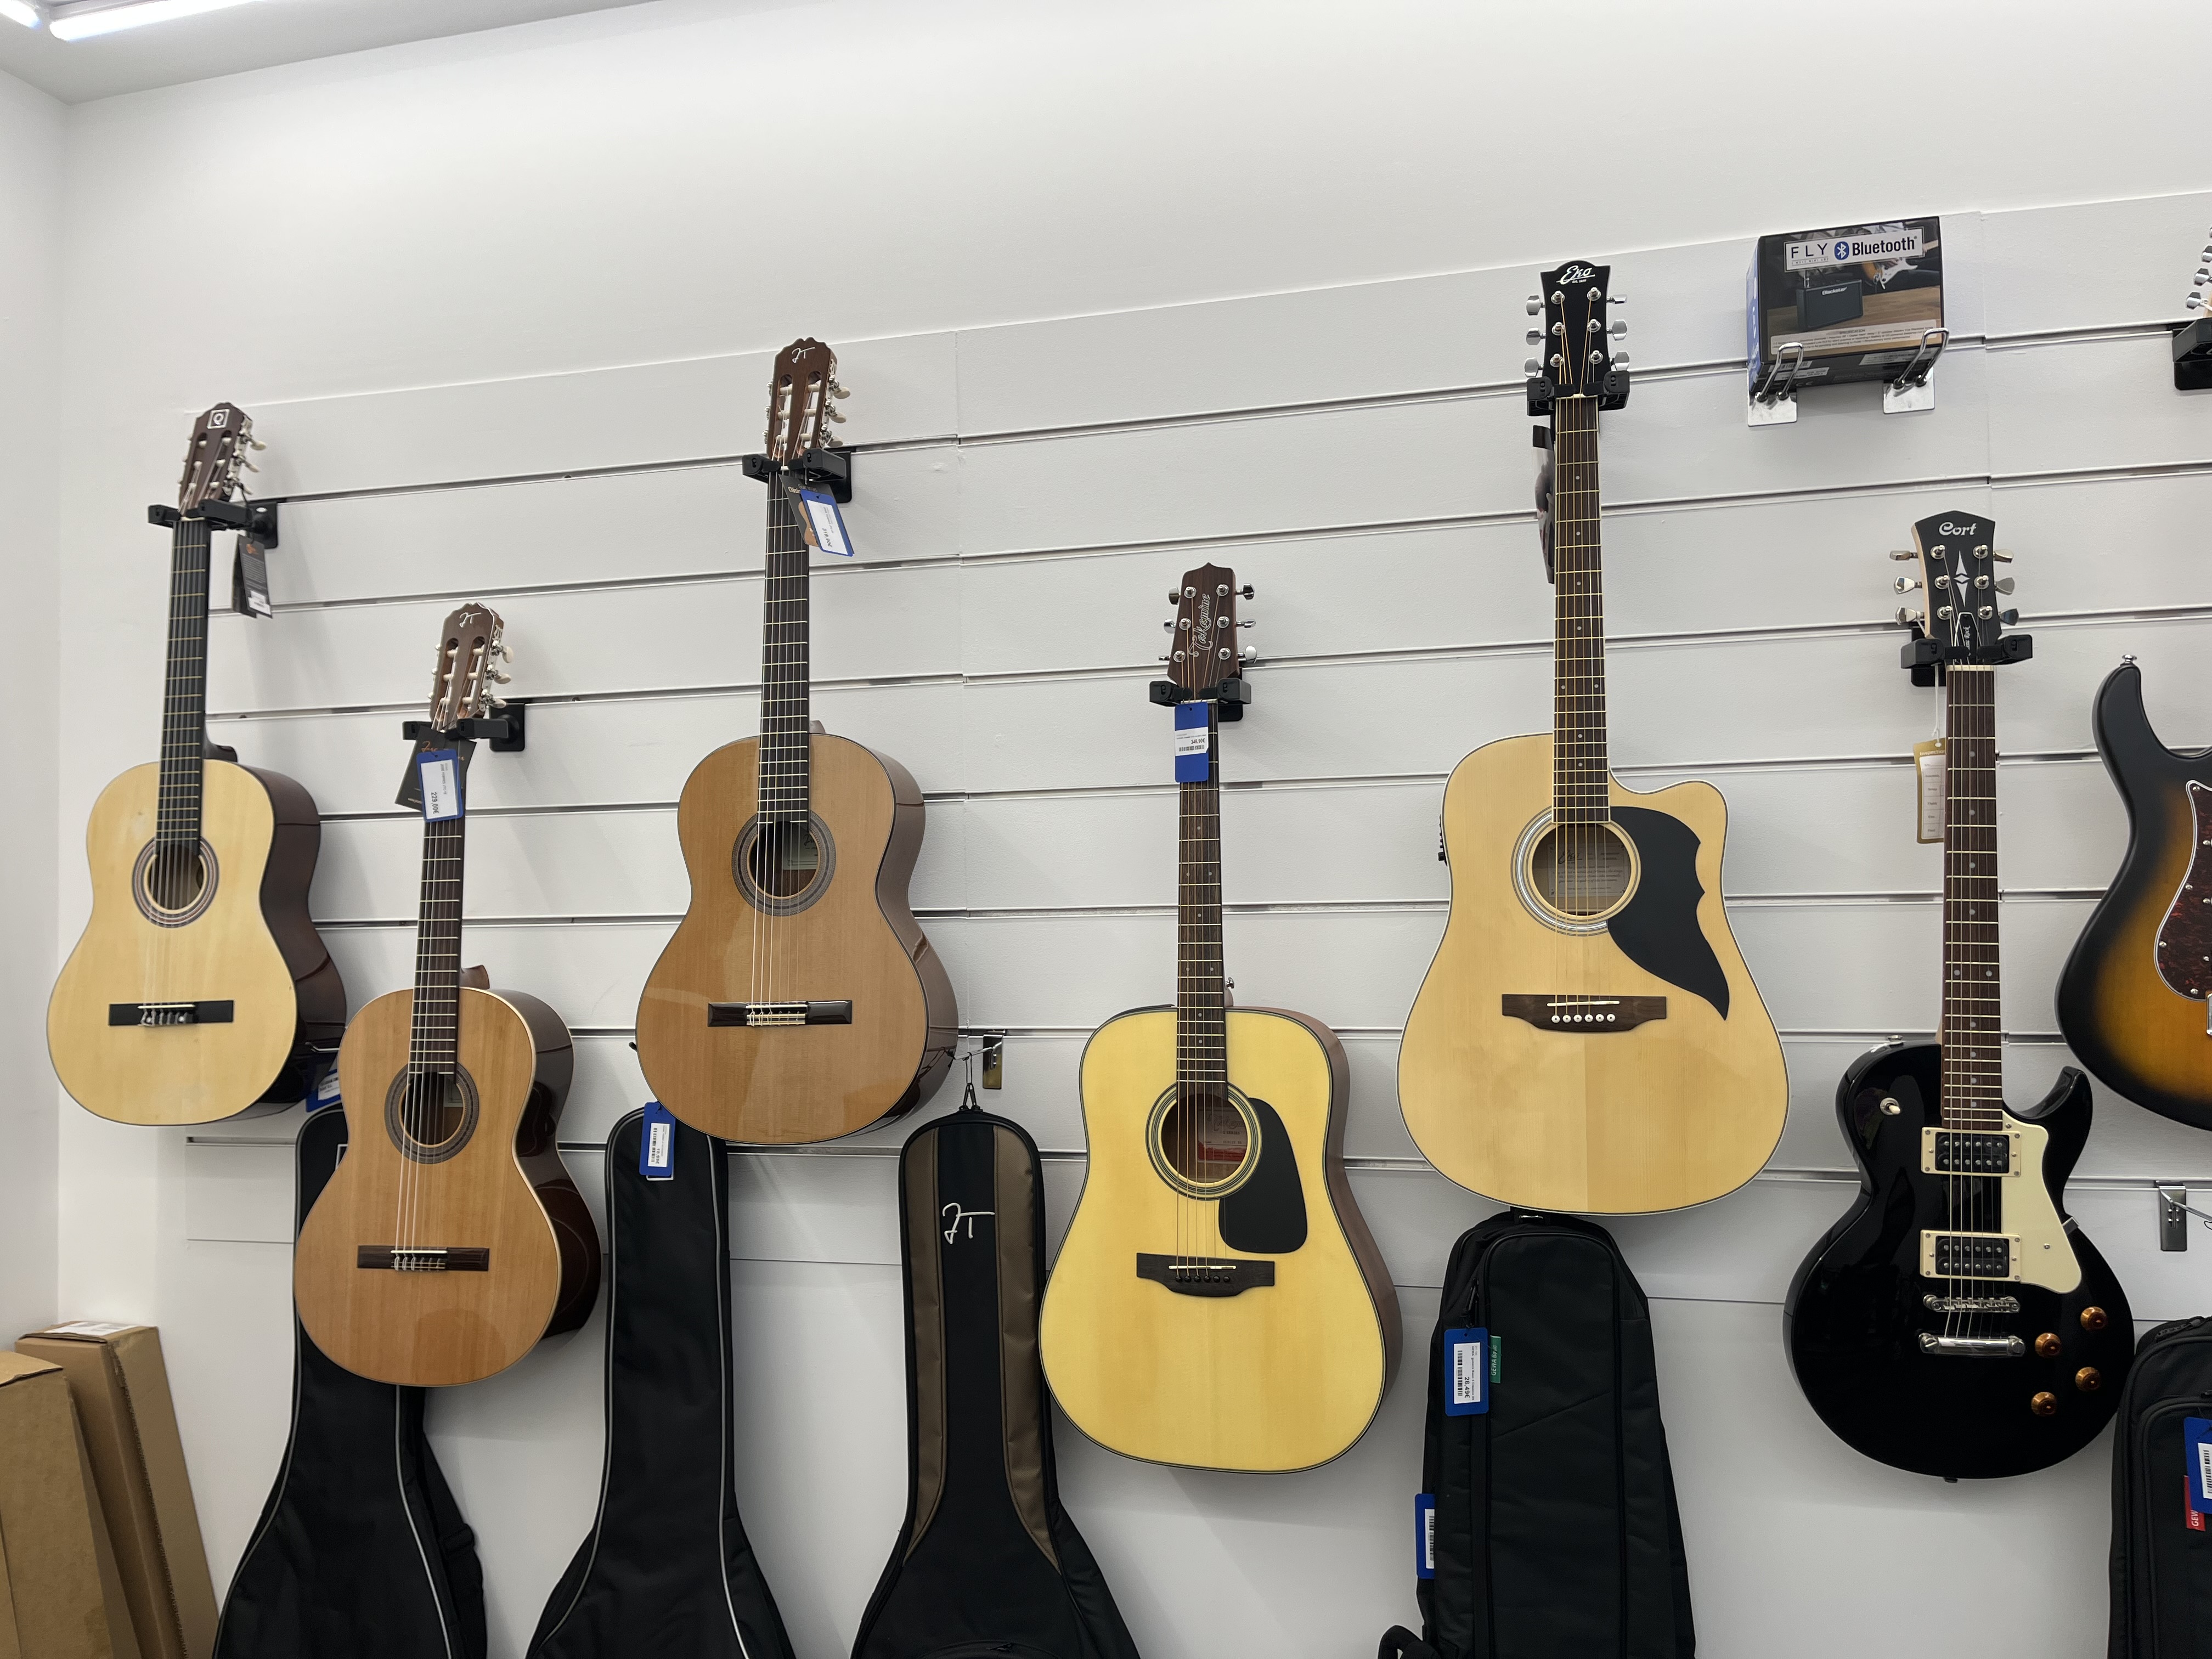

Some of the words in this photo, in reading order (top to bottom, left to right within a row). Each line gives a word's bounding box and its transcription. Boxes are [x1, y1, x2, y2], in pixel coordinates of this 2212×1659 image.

[1791, 243, 1828, 259] FLY
[1852, 236, 1915, 257] Bluetooth
[1938, 522, 1977, 536] Cort
[1188, 593, 1214, 658] Takamine
[431, 792, 439, 815] 229,00€
[2191, 1510, 2199, 1527] GEW
